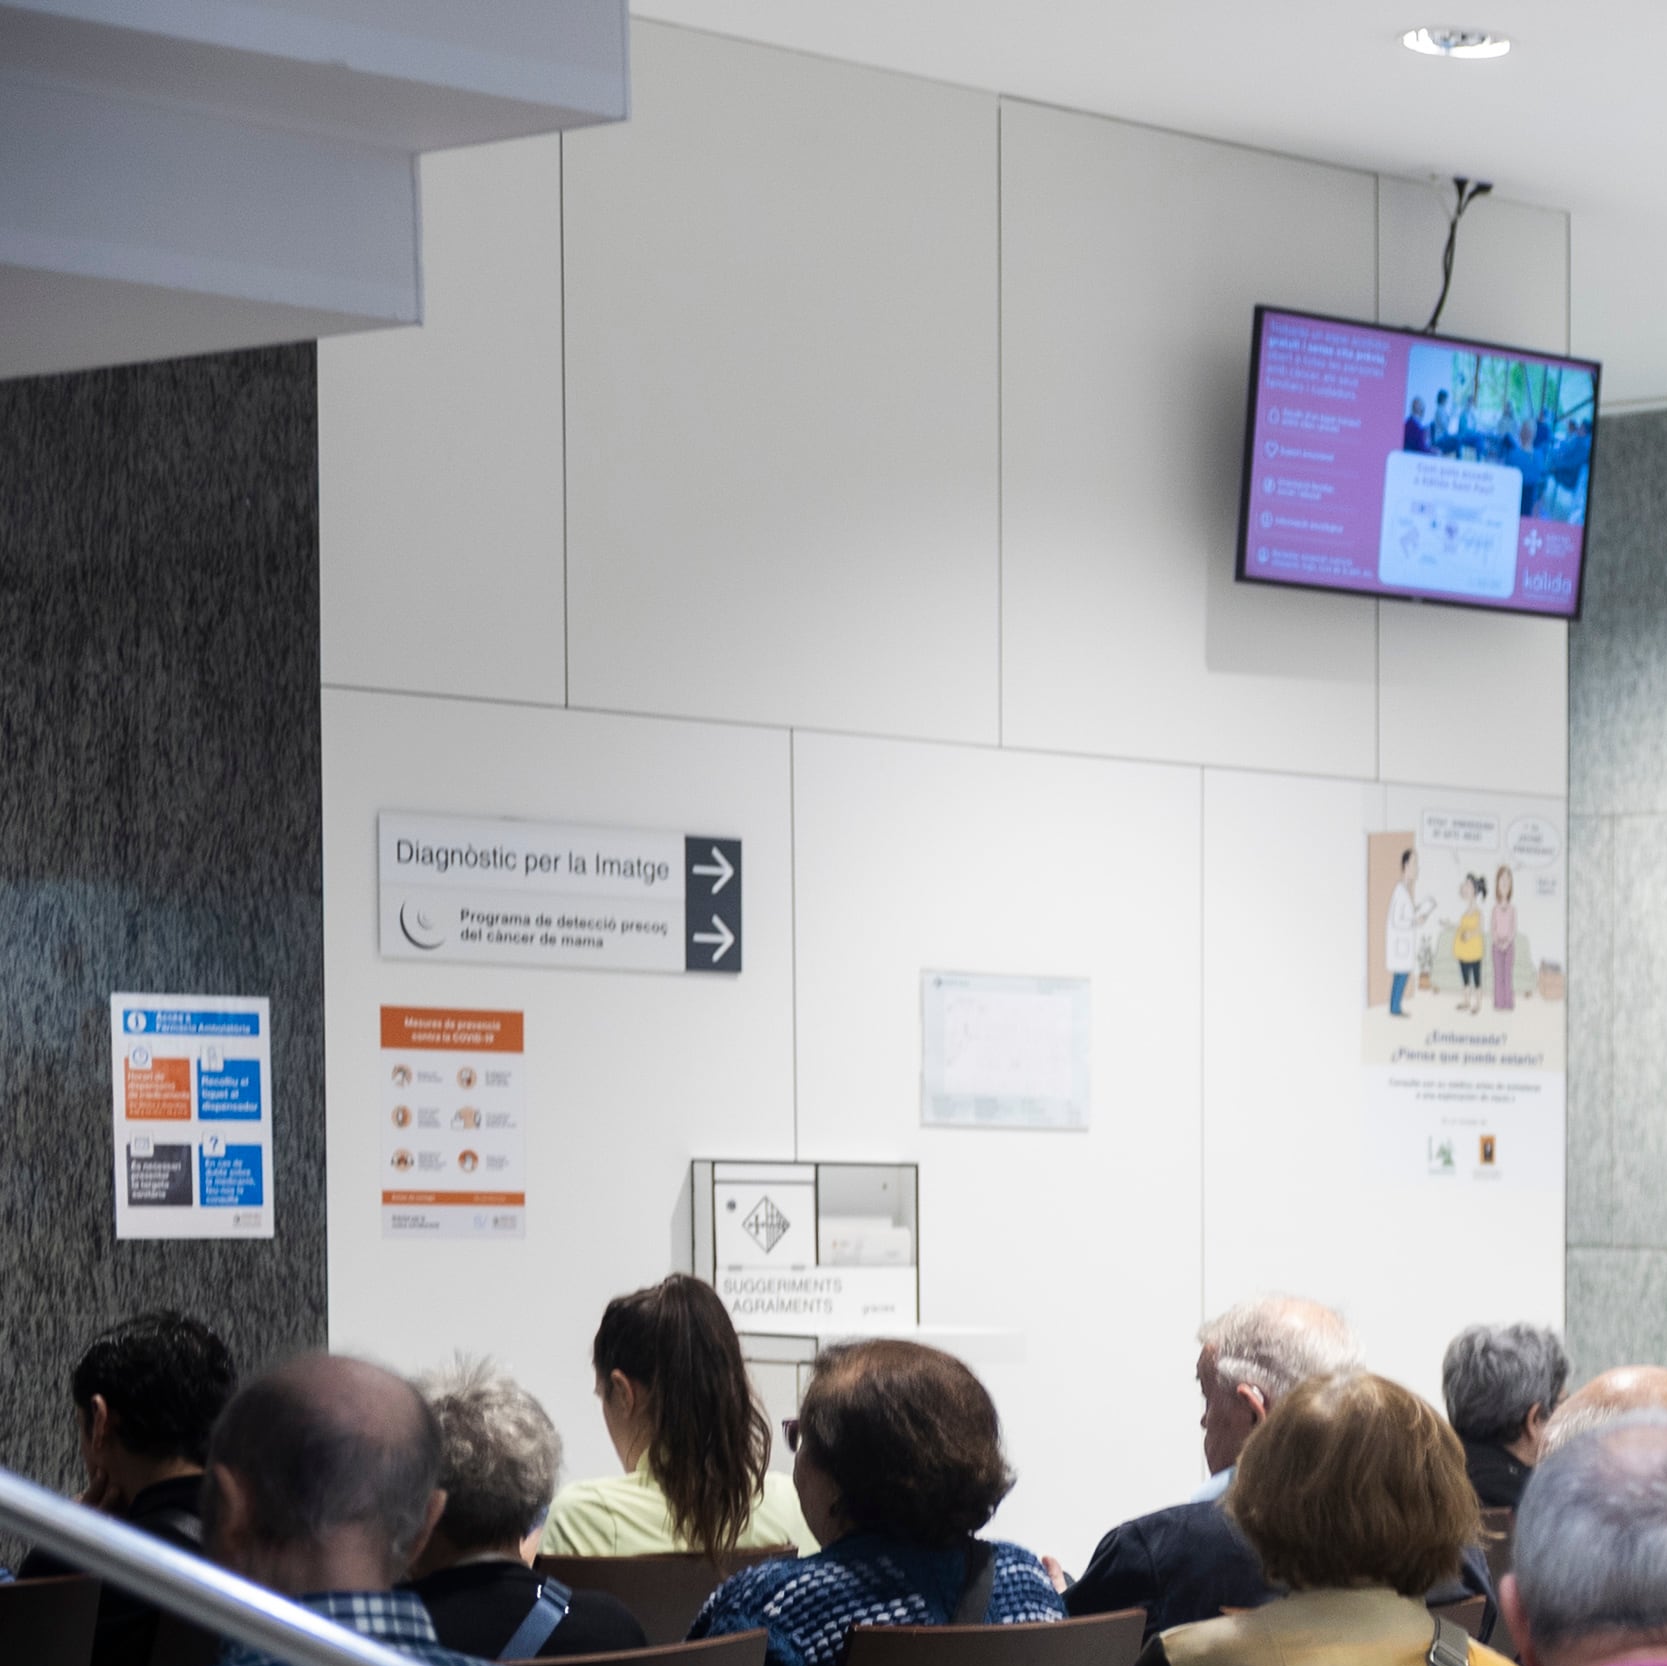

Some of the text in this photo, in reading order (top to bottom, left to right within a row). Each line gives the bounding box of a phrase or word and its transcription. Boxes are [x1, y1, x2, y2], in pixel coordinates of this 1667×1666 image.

[396, 839, 669, 886] Diagnòstic per la Imatge
[460, 907, 668, 936] Programa de detecció precoç
[460, 927, 604, 949] del càncer de mama
[201, 1075, 249, 1088] Recolliu el
[201, 1087, 240, 1101] tiquet al
[201, 1101, 258, 1114] dispensador
[723, 1277, 842, 1296] SUGGERIMENTS
[731, 1295, 833, 1315] AGRAÏMENTS
